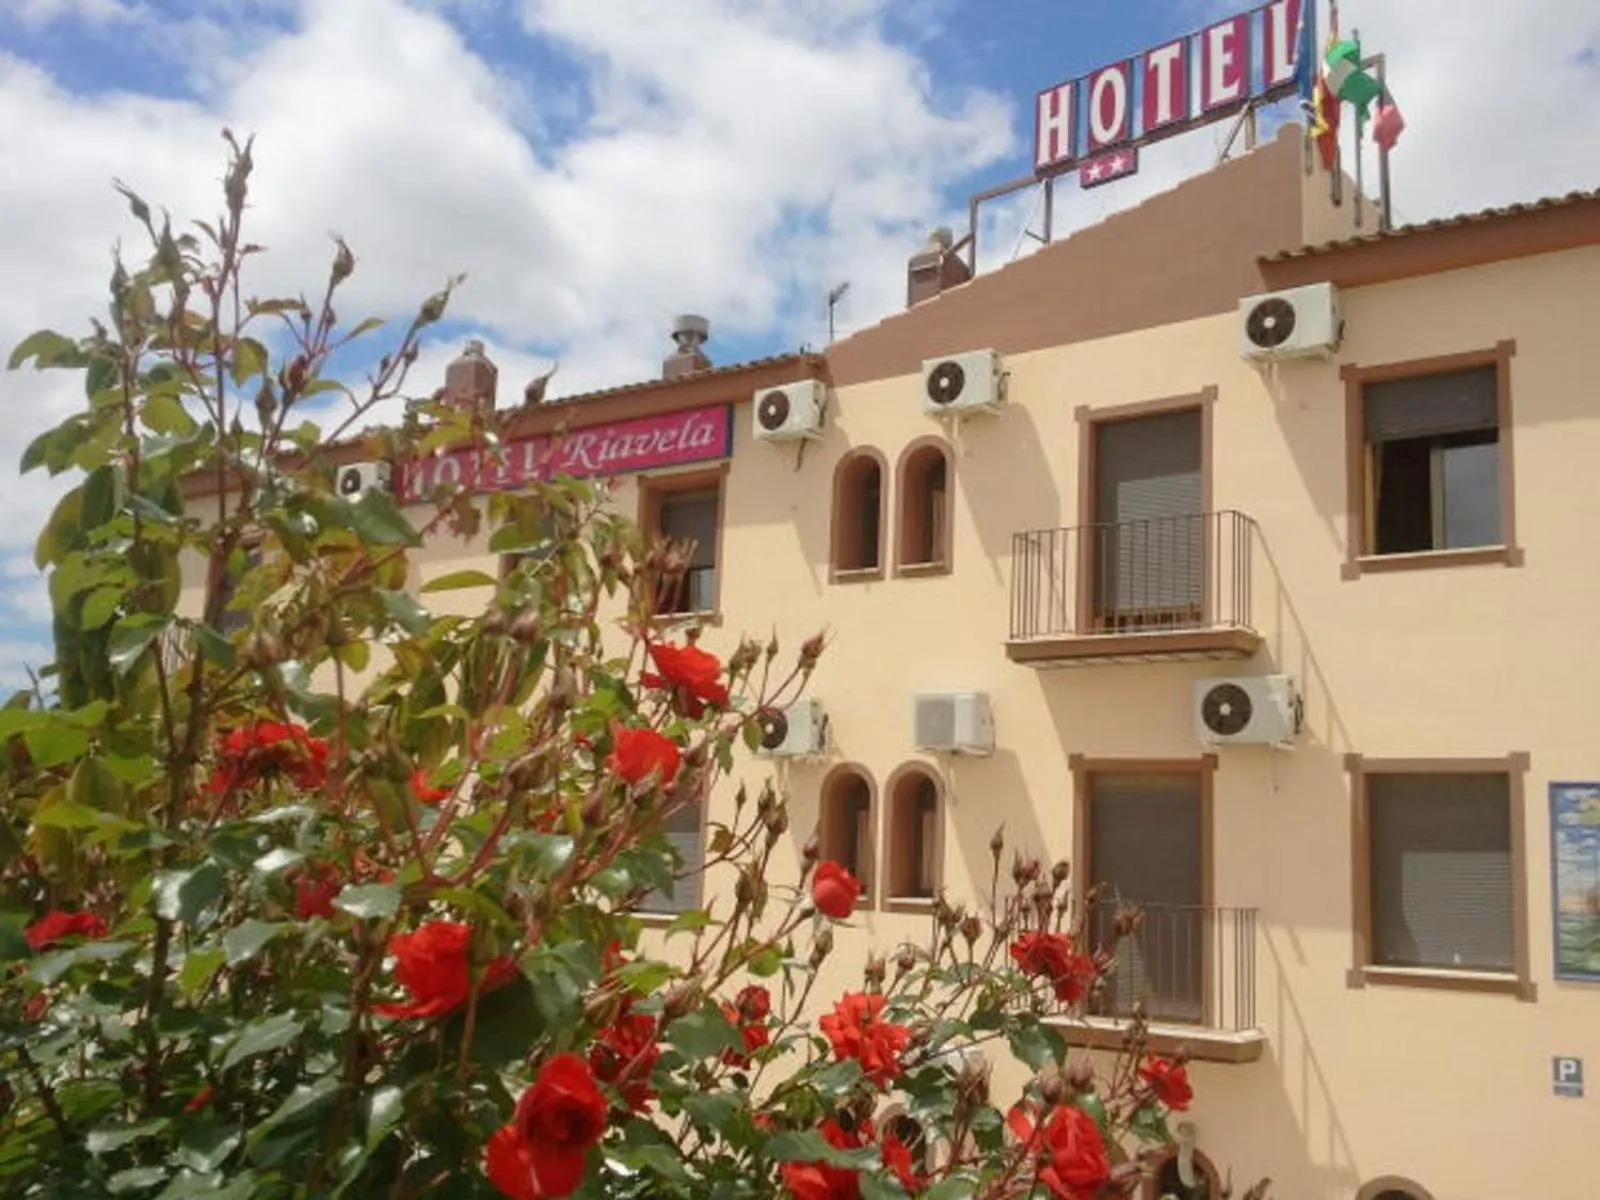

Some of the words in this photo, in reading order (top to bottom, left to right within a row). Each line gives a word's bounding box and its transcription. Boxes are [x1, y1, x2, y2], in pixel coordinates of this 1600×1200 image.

[1036, 1, 1299, 166] HOTEL
[560, 413, 716, 470] Riavela
[1559, 1060, 1576, 1081] P
